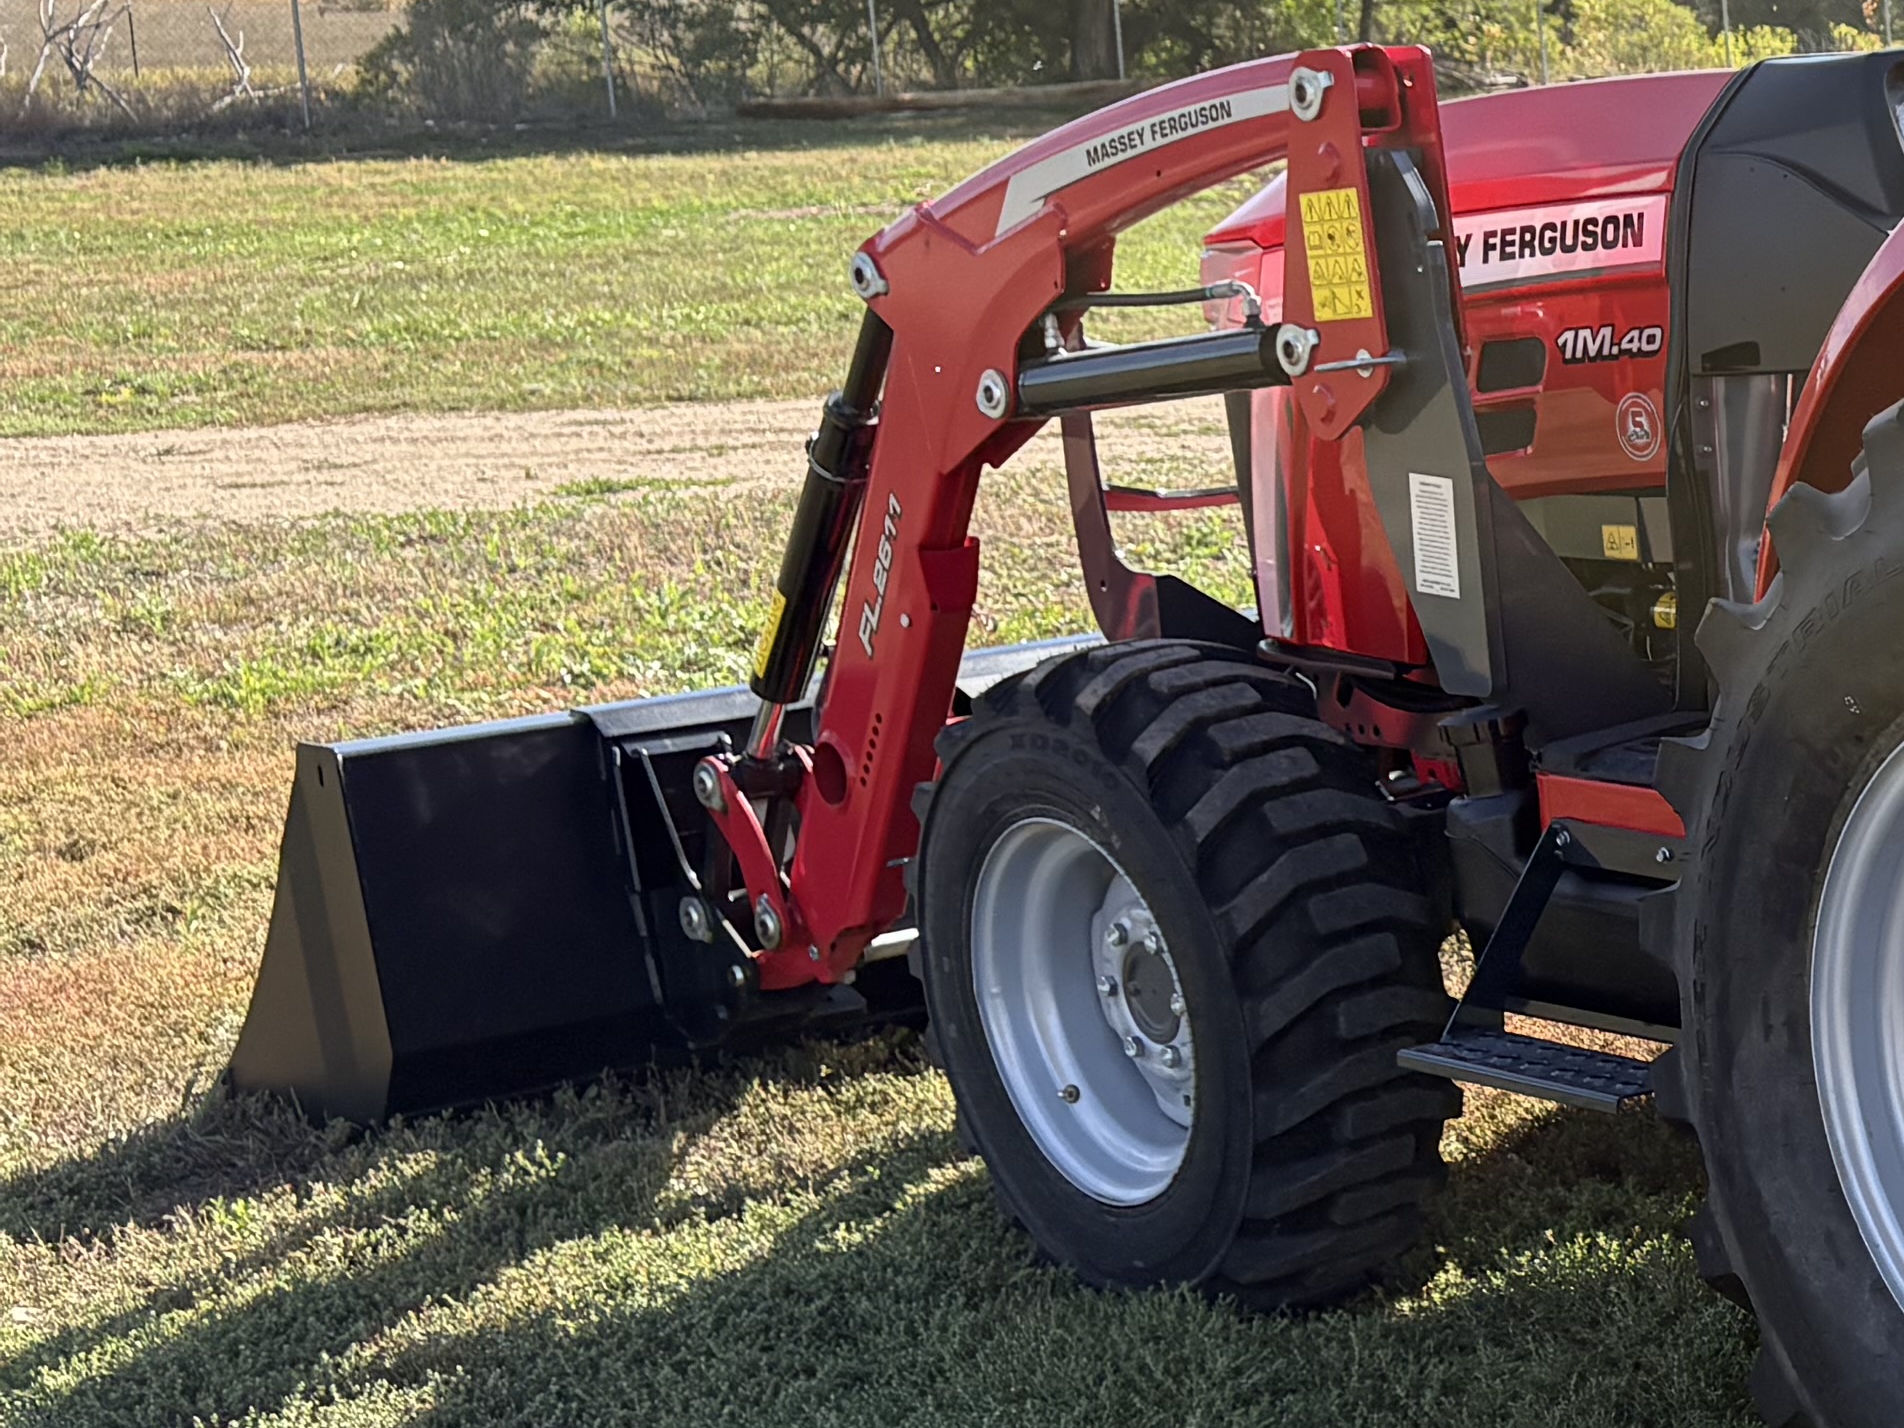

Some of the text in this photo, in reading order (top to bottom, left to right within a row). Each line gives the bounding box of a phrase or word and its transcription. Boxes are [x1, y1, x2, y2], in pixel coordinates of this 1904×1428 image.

[1085, 99, 1233, 167] MASSEY FERGUSON
[1481, 211, 1645, 265] FERGUSON
[1556, 324, 1664, 362] 1M.40
